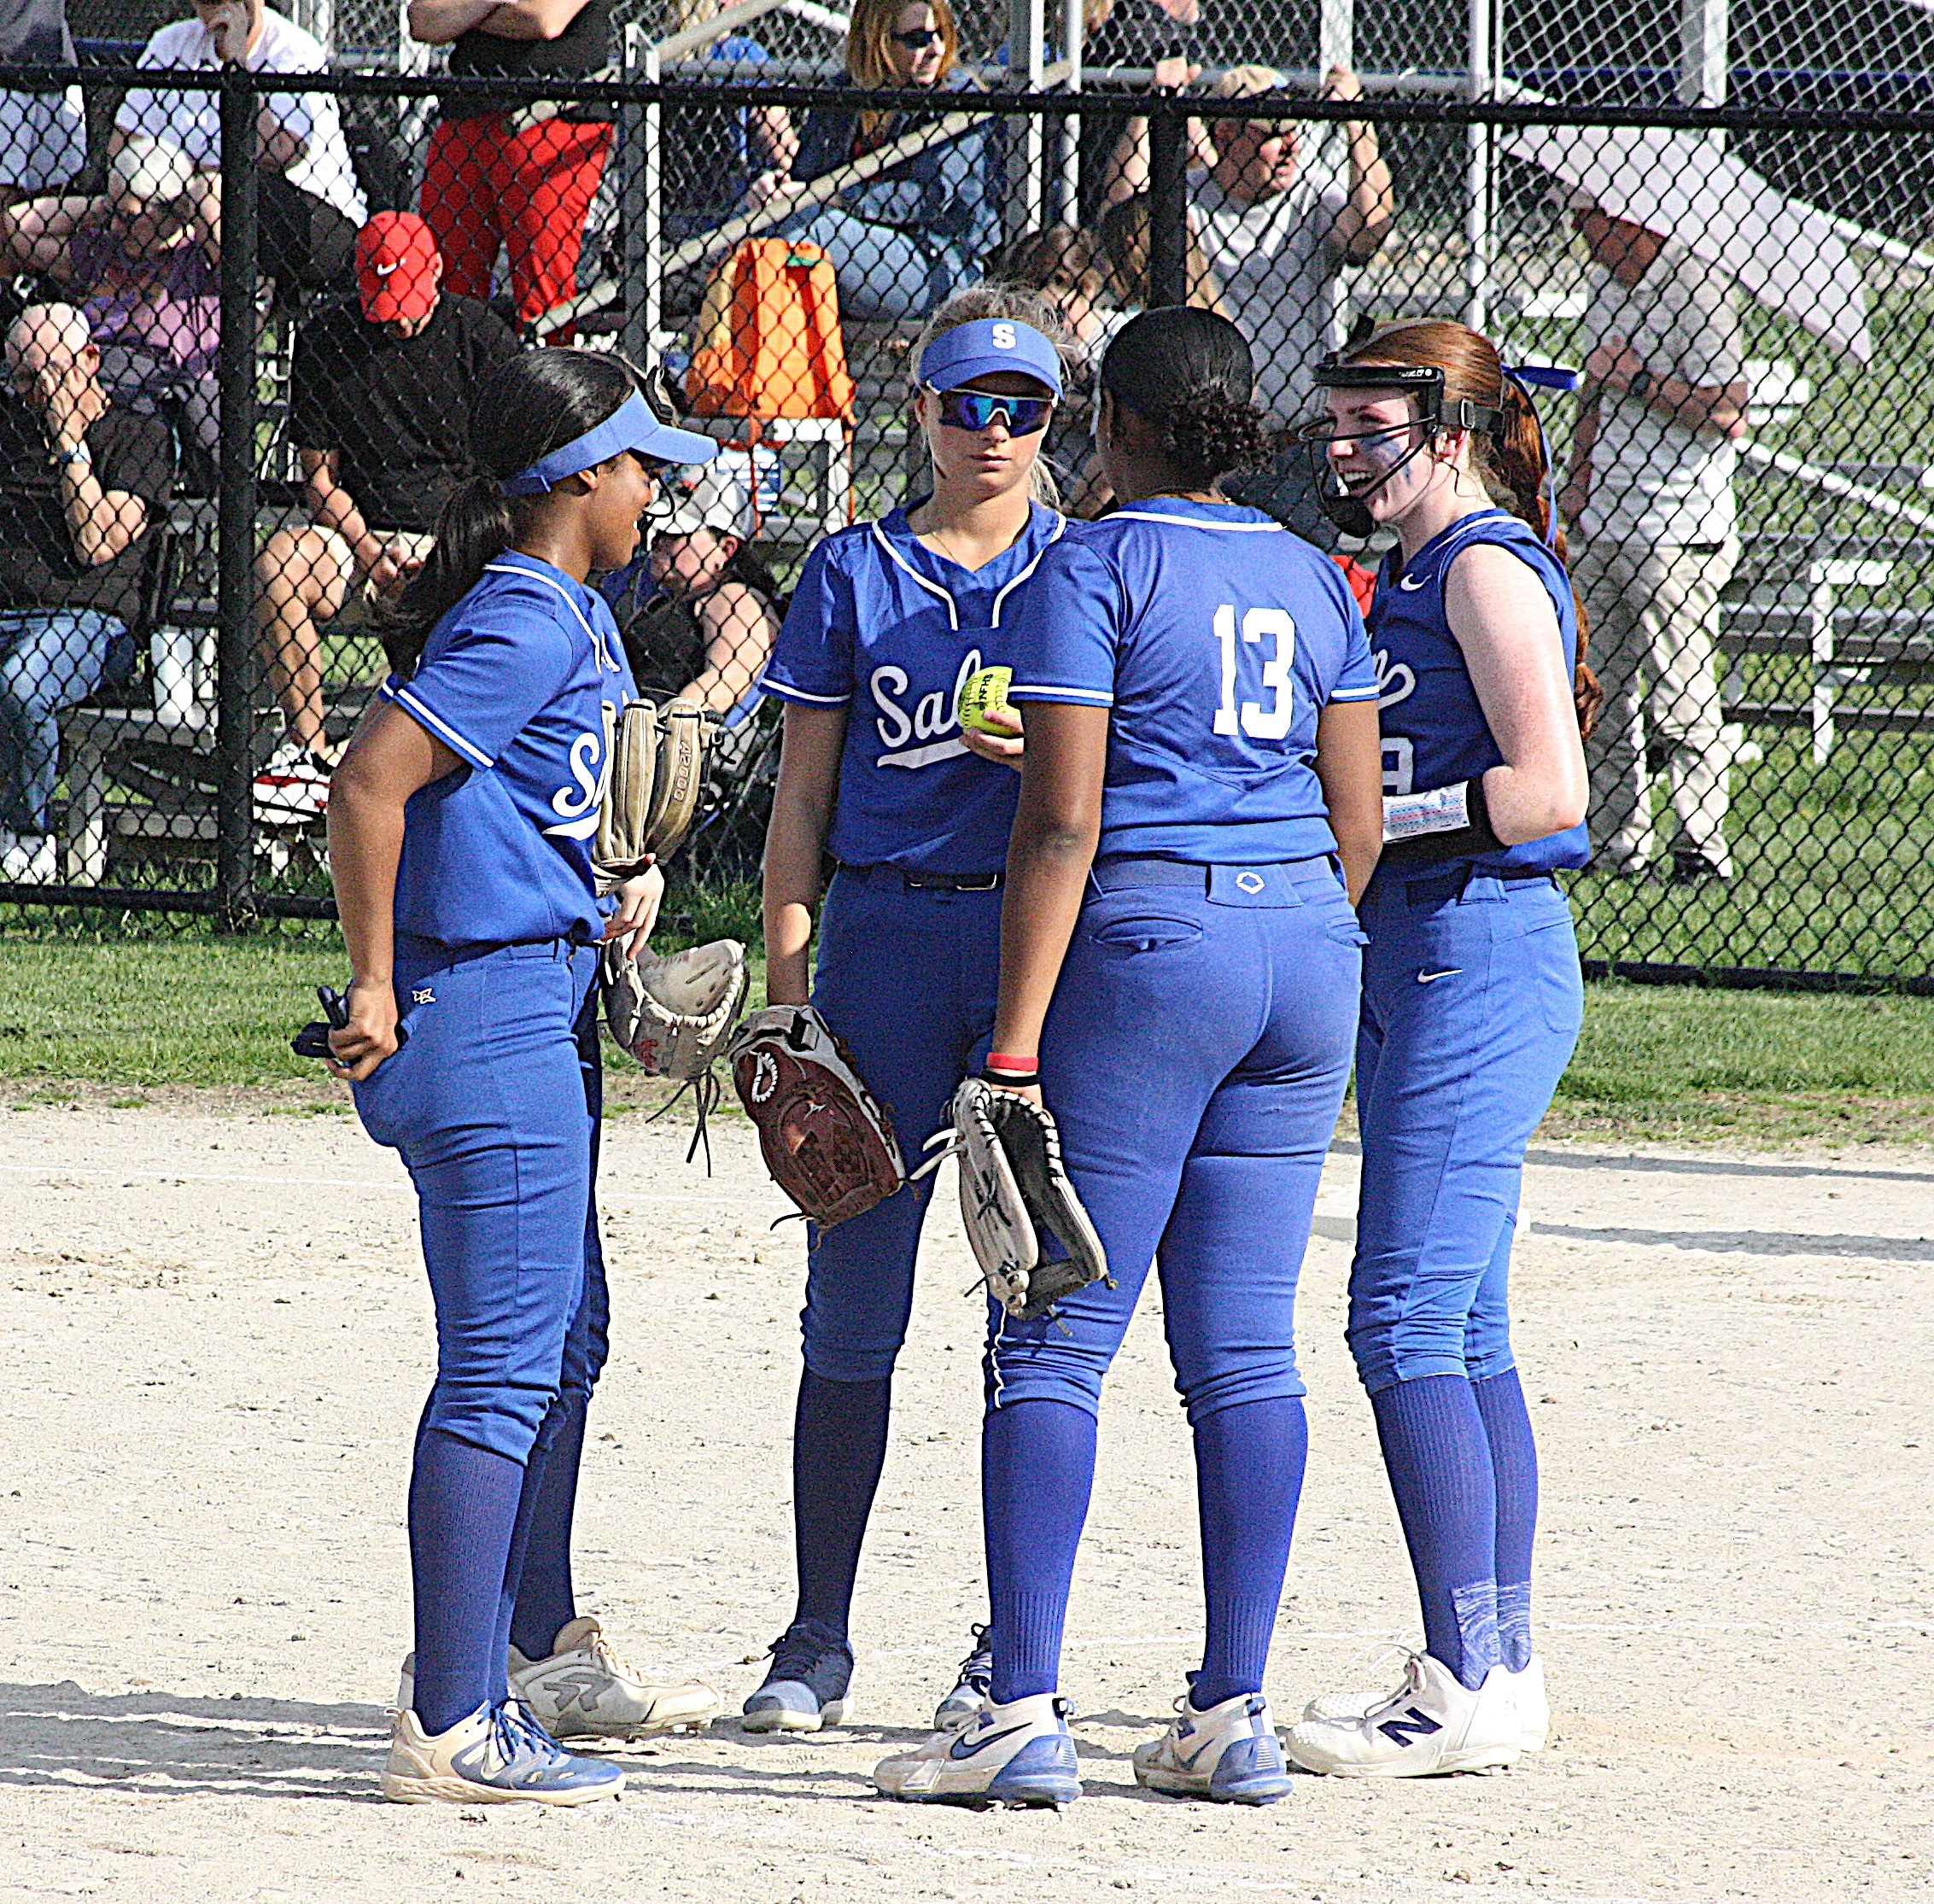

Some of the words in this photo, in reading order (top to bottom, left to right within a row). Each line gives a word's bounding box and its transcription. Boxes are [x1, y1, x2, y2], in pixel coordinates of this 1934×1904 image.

[992, 324, 1016, 350] S
[871, 649, 981, 748] Sal
[1212, 604, 1296, 740] 13
[672, 740, 692, 802] A2000
